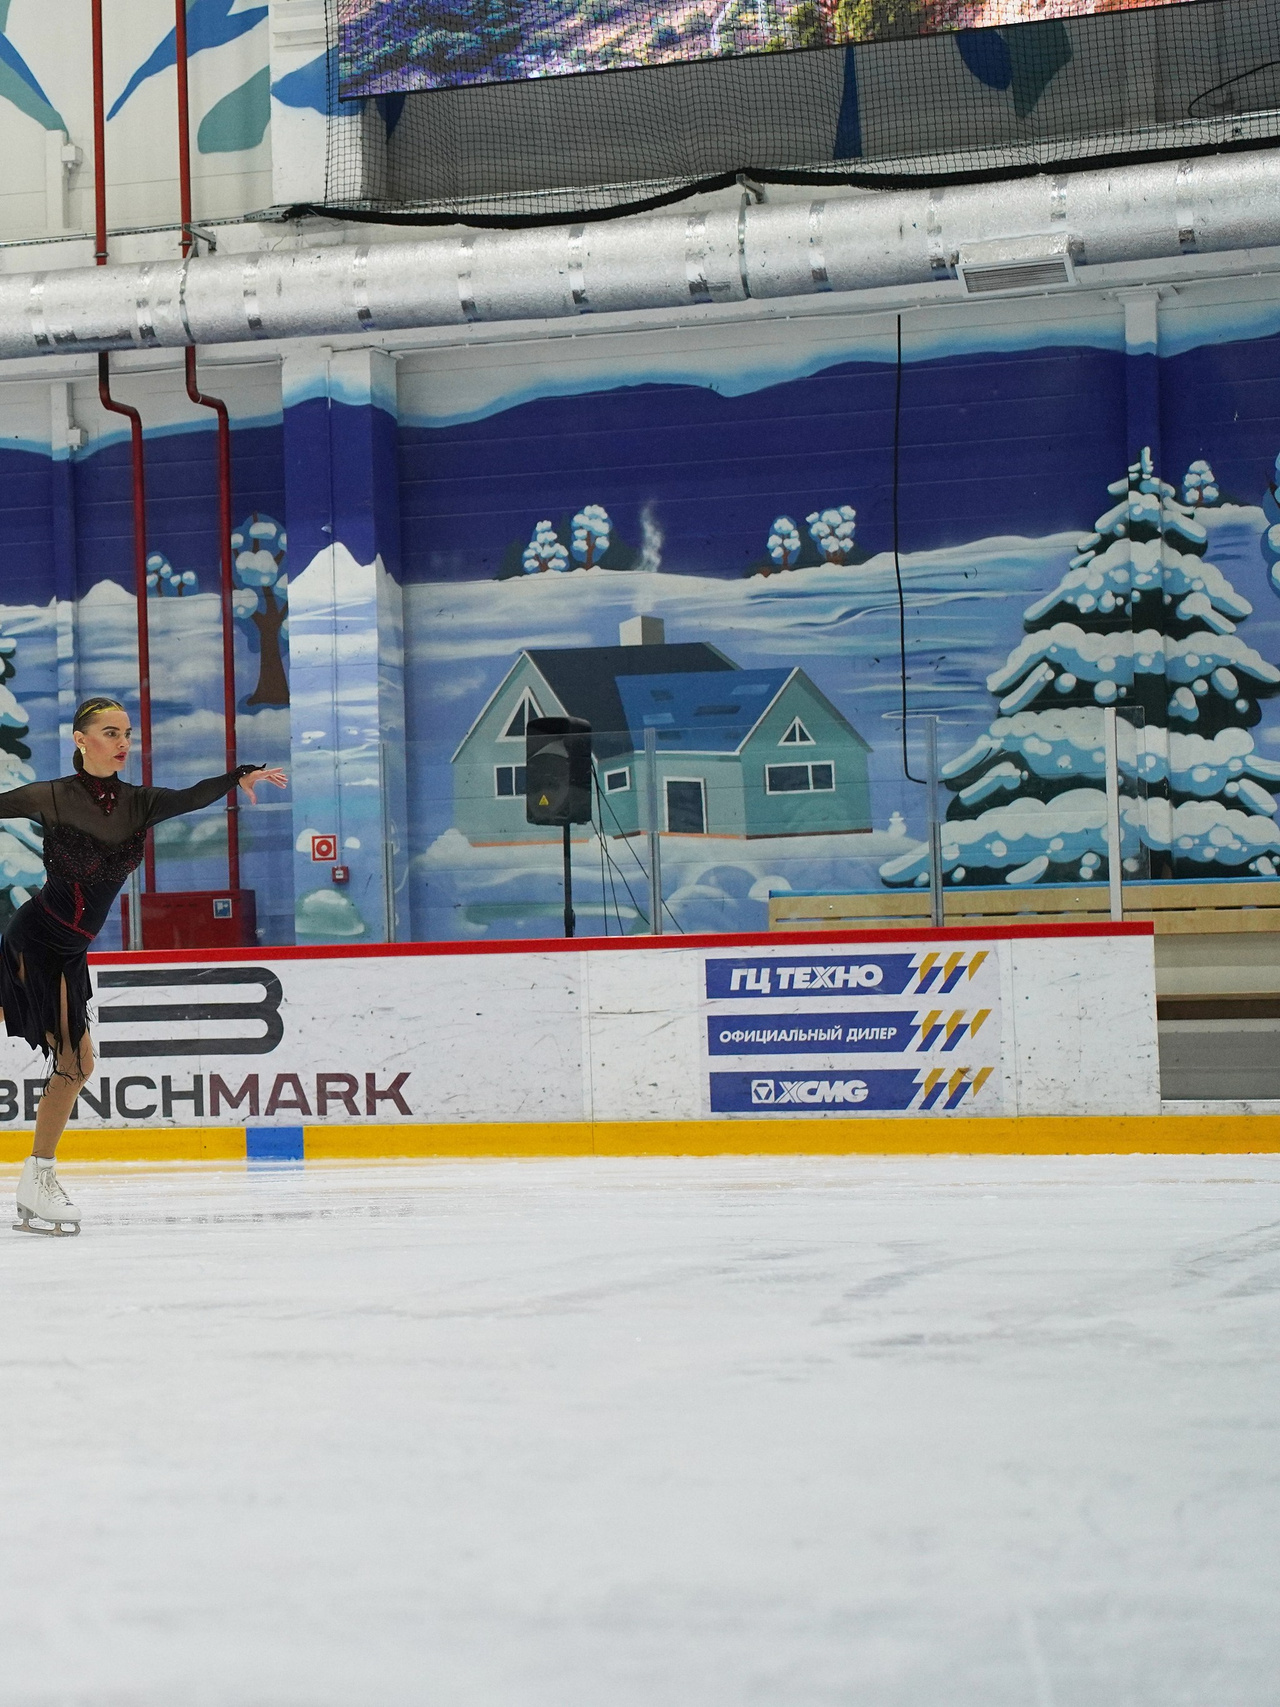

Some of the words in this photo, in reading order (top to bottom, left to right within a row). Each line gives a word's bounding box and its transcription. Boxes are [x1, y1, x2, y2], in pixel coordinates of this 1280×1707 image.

[729, 968, 771, 994] ГЦ
[776, 963, 884, 990] ТЕХНО
[719, 1025, 843, 1044] ОФИЦИАЛЬНЫЙ
[845, 1026, 898, 1043] ДИЛЕР
[774, 1079, 869, 1104] XCMG
